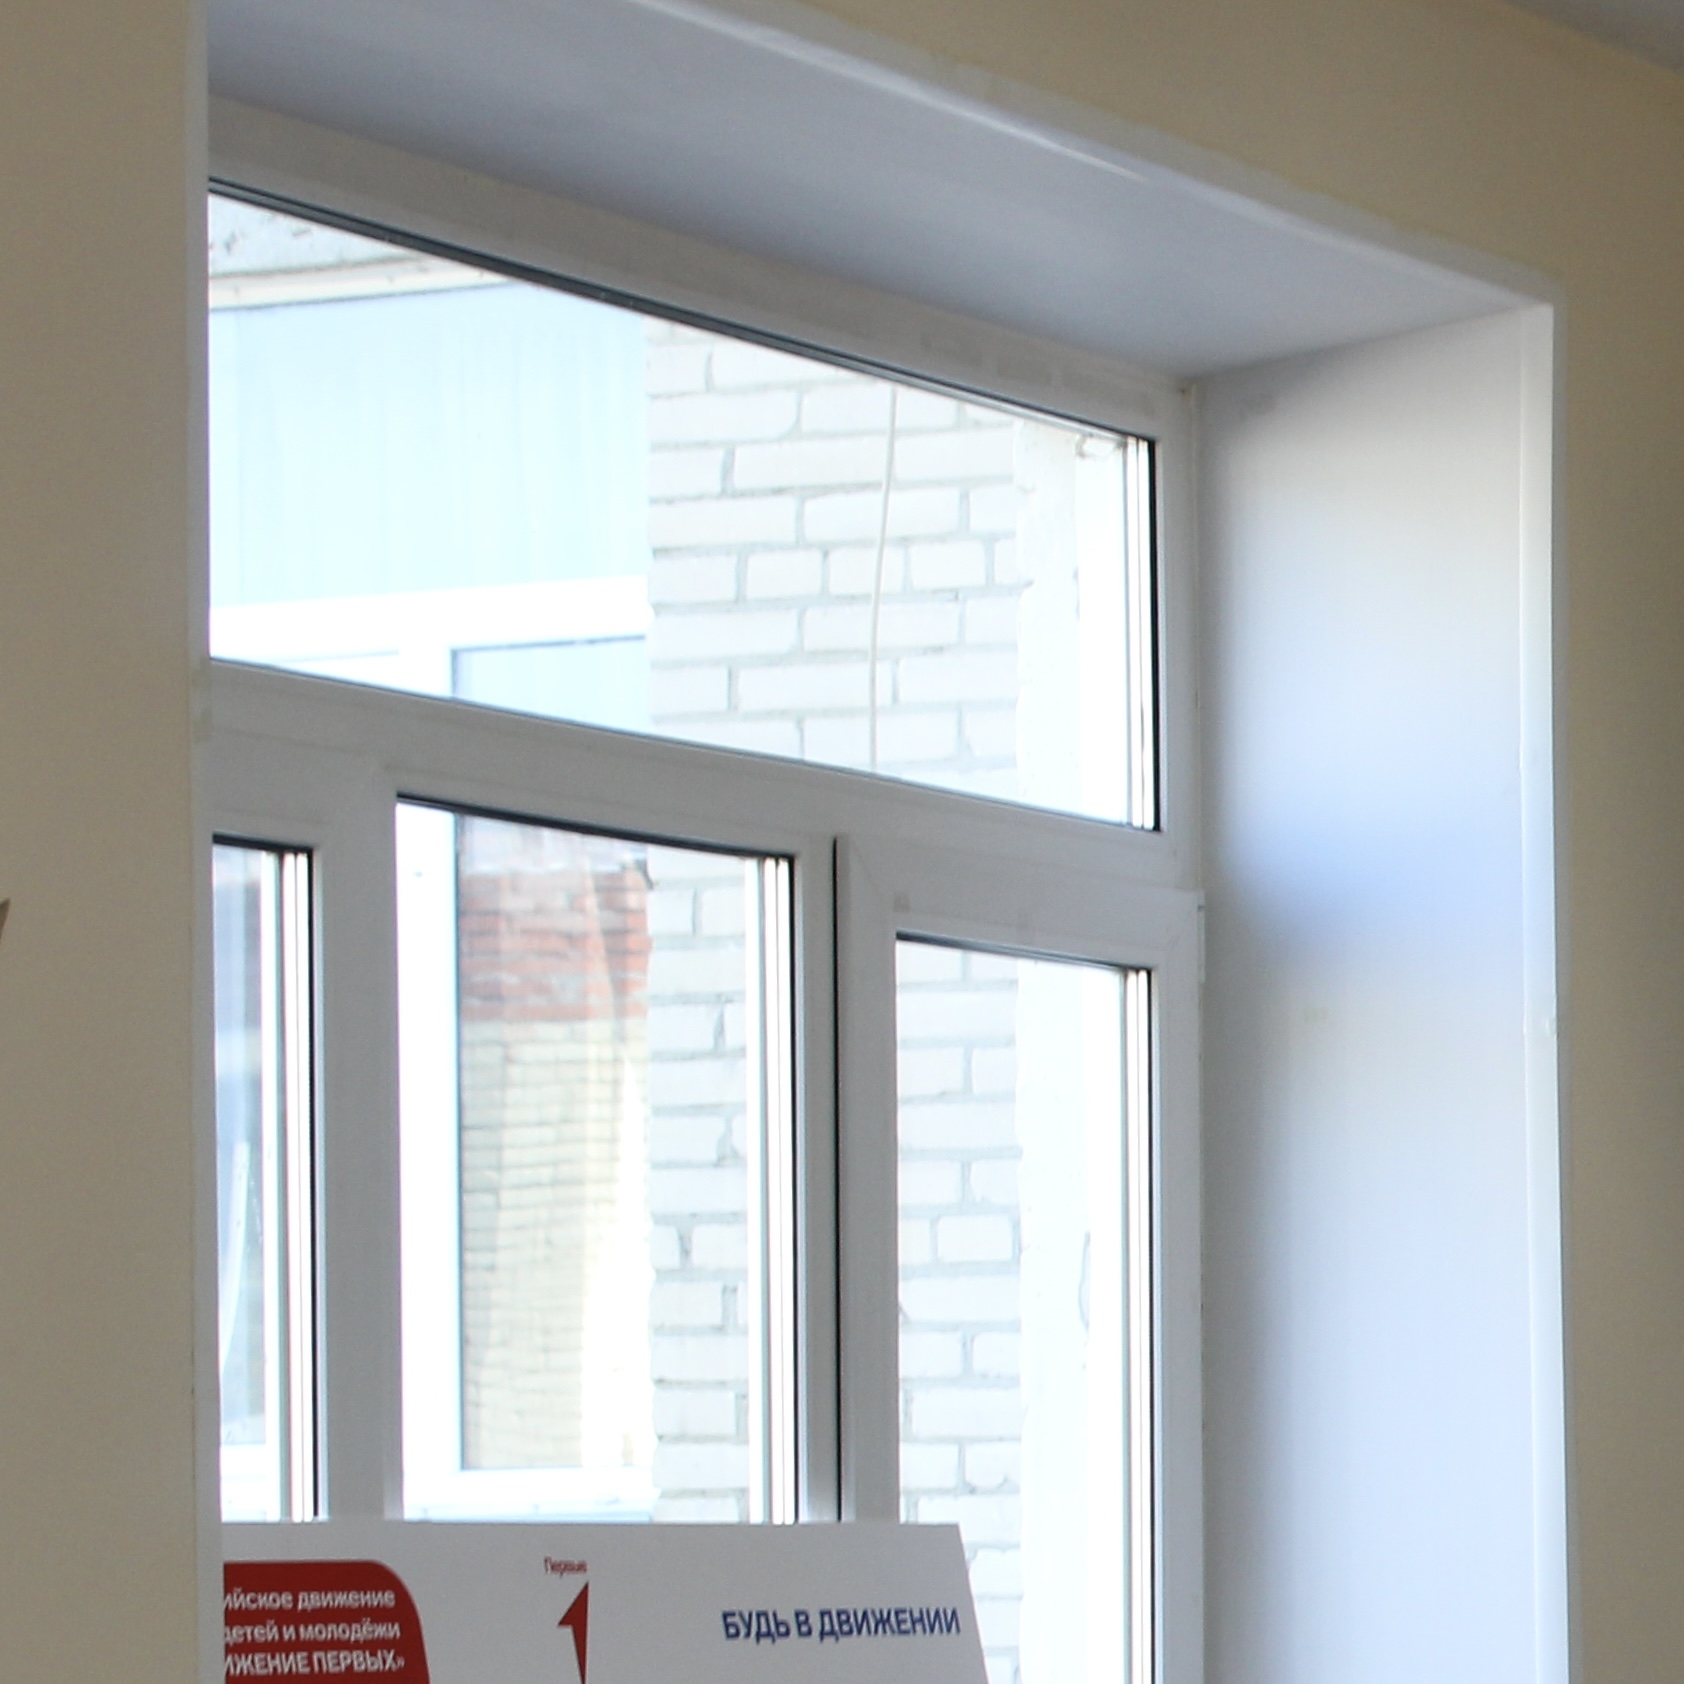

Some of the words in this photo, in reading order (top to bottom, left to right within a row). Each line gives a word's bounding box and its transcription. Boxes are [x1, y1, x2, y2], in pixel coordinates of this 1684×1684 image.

[297, 1589, 396, 1611] движение
[283, 1623, 296, 1642] и
[300, 1617, 401, 1643] молодёжи
[722, 1609, 791, 1644] БУДЬ
[795, 1609, 812, 1639] В
[818, 1607, 961, 1644] ДВИЖЕНИИ
[313, 1649, 405, 1675] ПЕРВЫХ»
